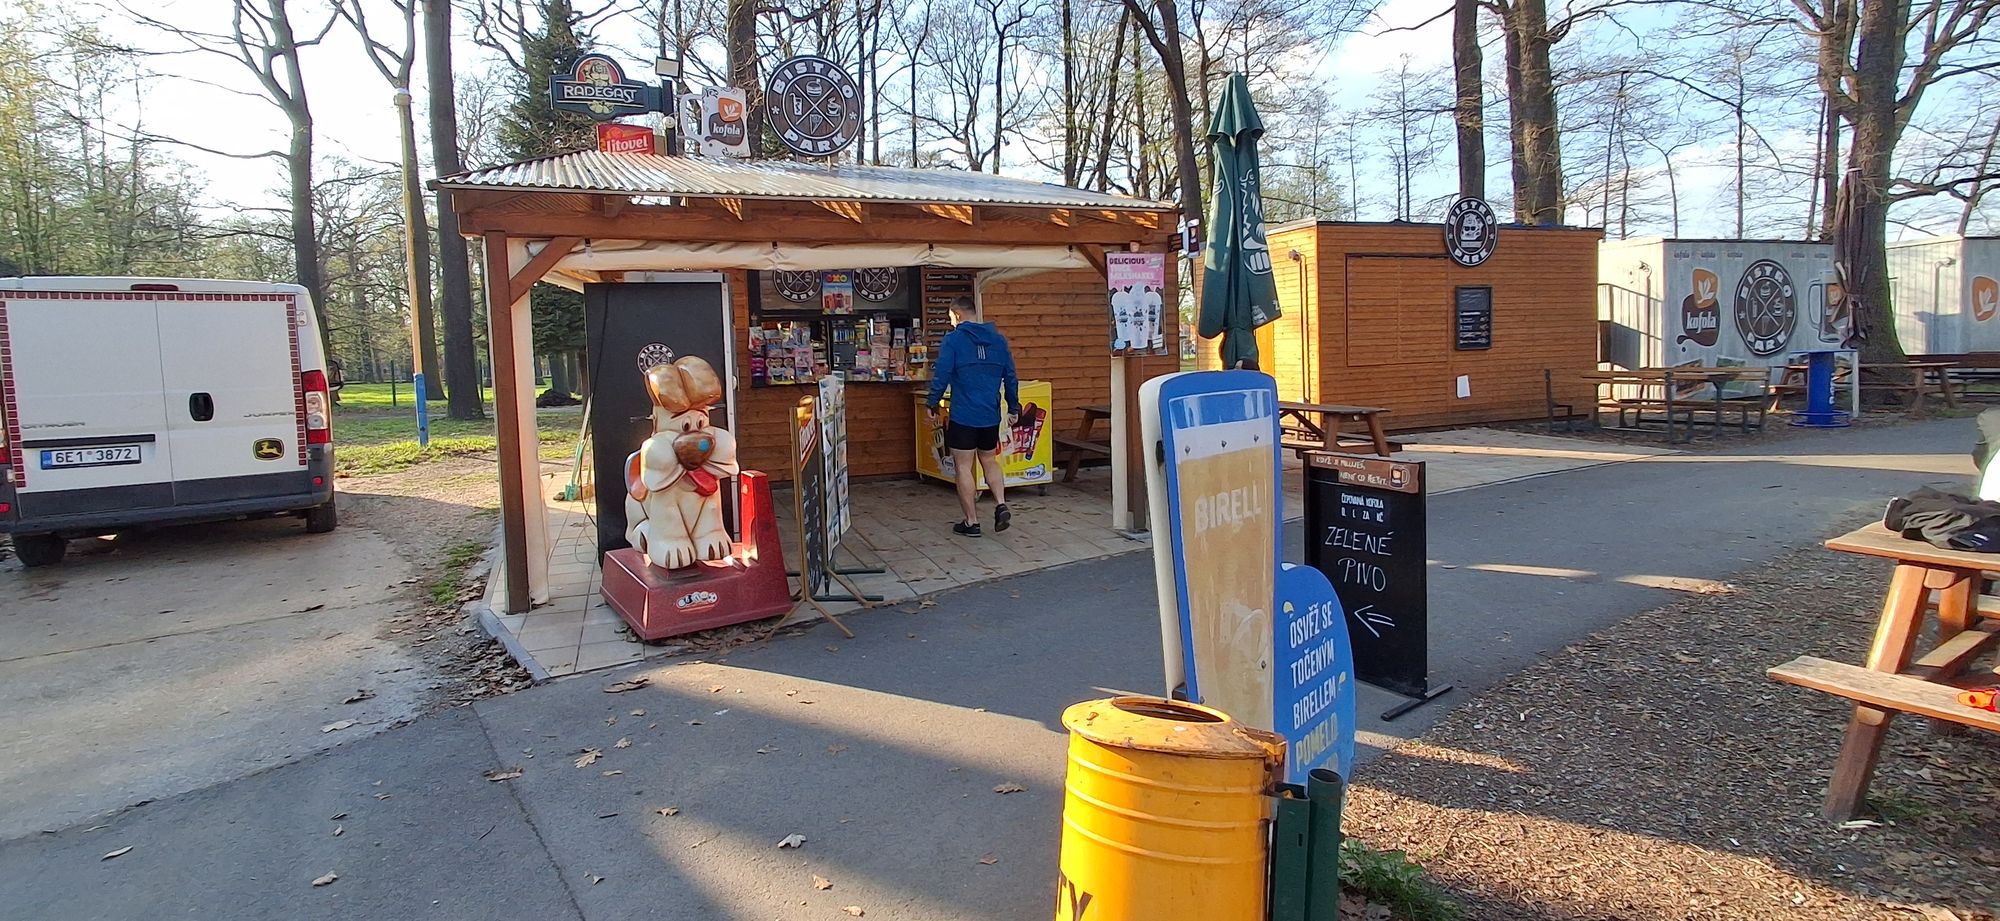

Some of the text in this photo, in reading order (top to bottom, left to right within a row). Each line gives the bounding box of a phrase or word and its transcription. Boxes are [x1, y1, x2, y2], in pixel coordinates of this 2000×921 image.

[772, 61, 854, 99] BISTRO
[563, 85, 637, 103] RADEGAST
[712, 122, 741, 137] kofola
[783, 128, 847, 152] PARK
[606, 135, 648, 152] litovel
[1450, 200, 1494, 225] BISTRO
[1109, 257, 1146, 265] DELICIOUS
[1454, 248, 1489, 264] PARK
[1740, 265, 1793, 298] BISTRO
[1686, 311, 1716, 334] kofola
[1747, 331, 1787, 351] PARK
[55, 448, 132, 463] 6E1 3872
[1195, 486, 1262, 534] BIRELL
[1365, 497, 1384, 509] KOFOLA
[1362, 510, 1370, 520] ZA
[1325, 526, 1395, 556] ZELENÉ
[1337, 557, 1386, 592] PIVO
[1322, 600, 1333, 630] SE
[1290, 637, 1335, 689] TOČENÝM
[1293, 675, 1337, 730] BIRELLEM
